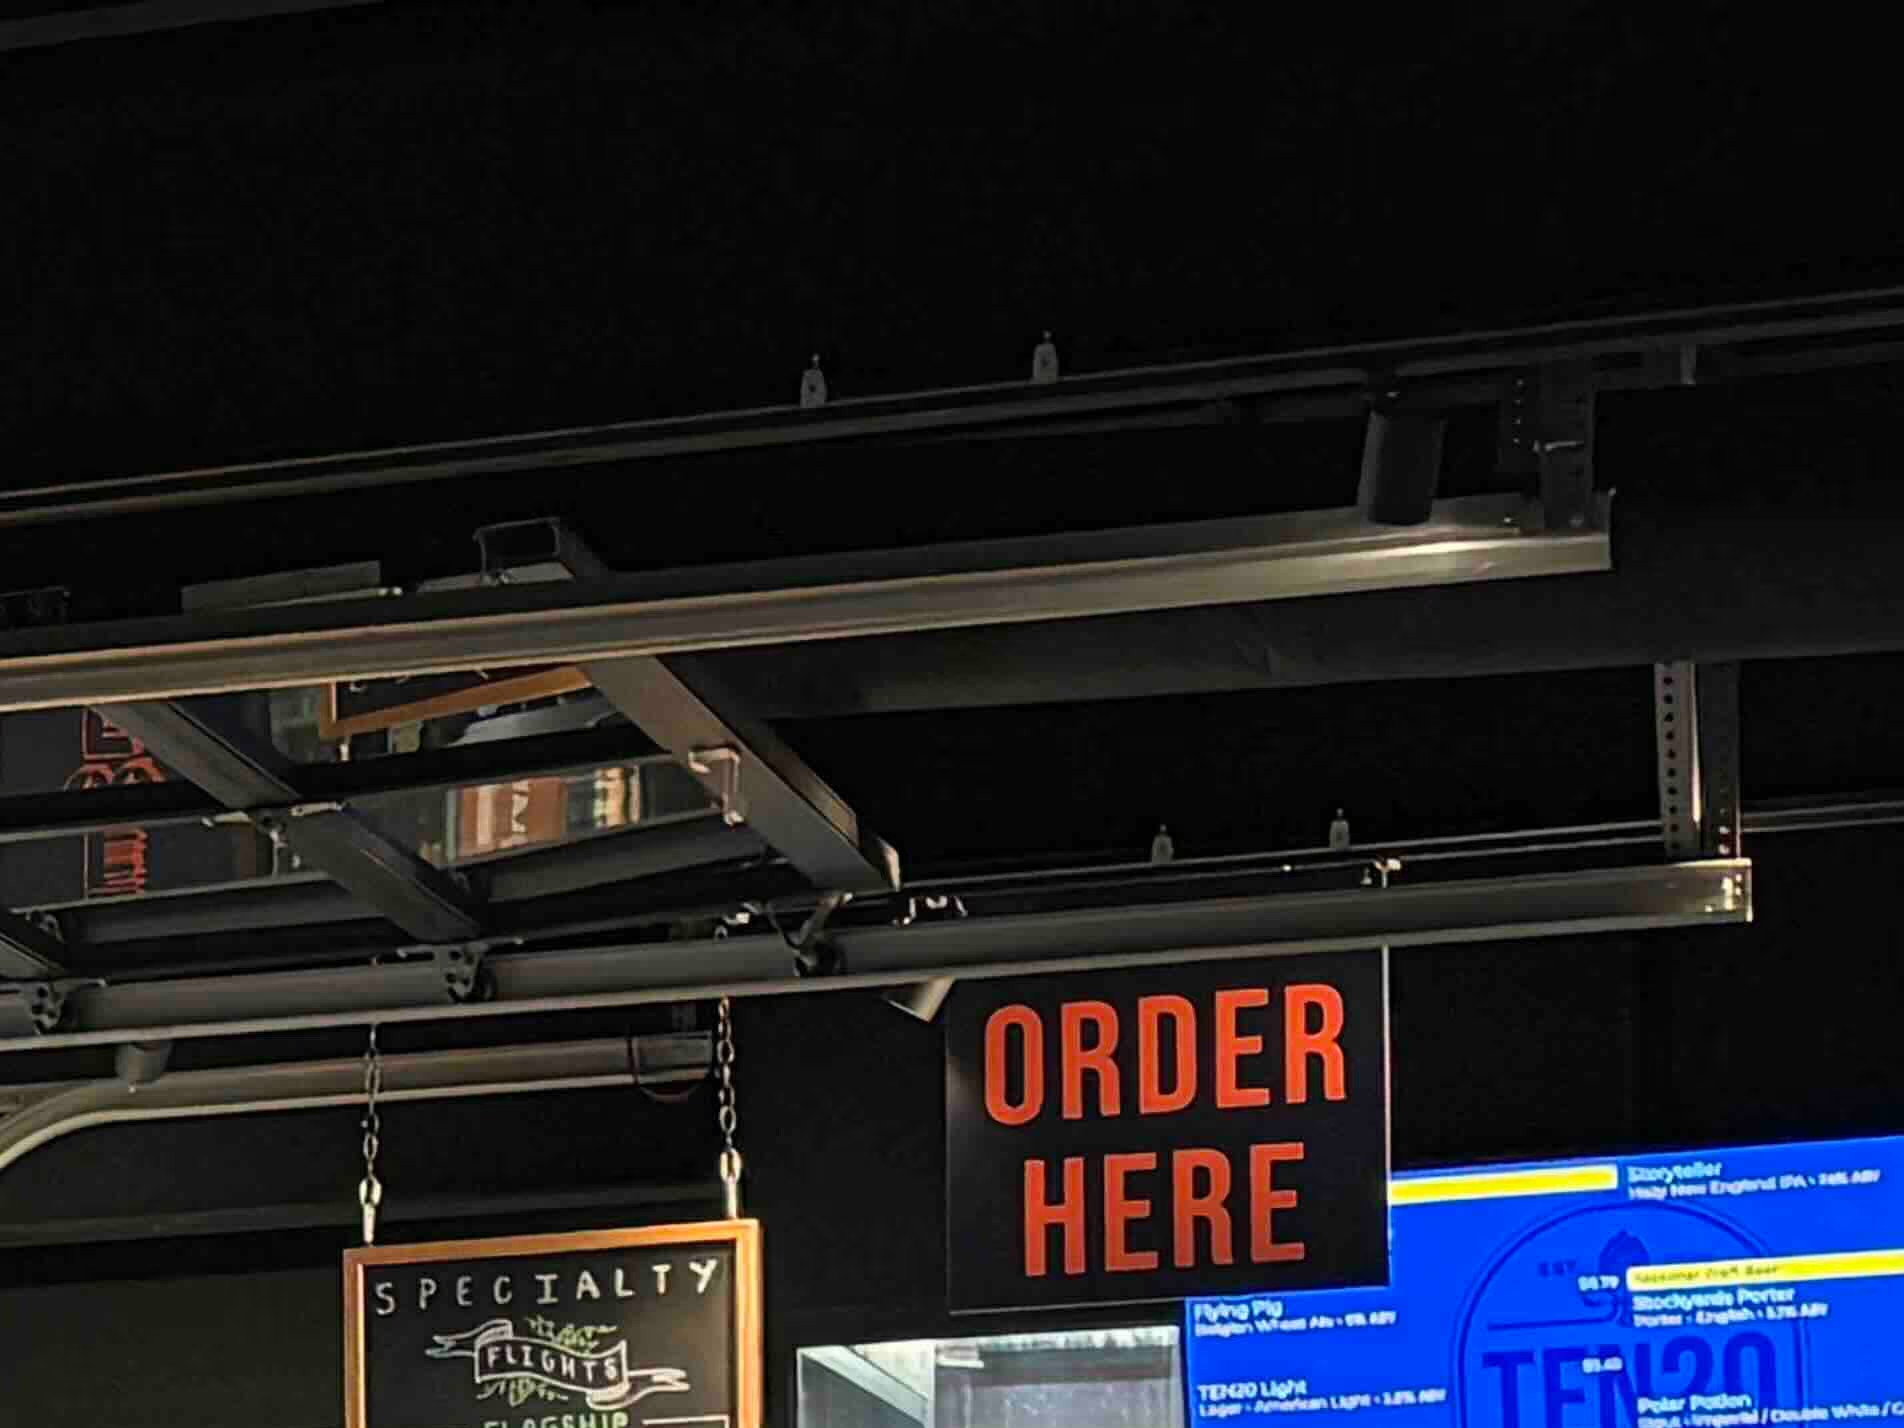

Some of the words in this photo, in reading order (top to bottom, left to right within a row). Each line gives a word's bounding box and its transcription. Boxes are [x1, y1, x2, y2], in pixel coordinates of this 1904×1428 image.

[984, 984, 1345, 1125] ORDER
[1024, 1142, 1305, 1277] HERE
[375, 1259, 718, 1315] SPECIALTY
[1194, 1301, 1249, 1321] Flying
[1251, 1299, 1283, 1319] Pig
[487, 1345, 616, 1381] FLIGHTS
[1259, 1379, 1307, 1399] Light
